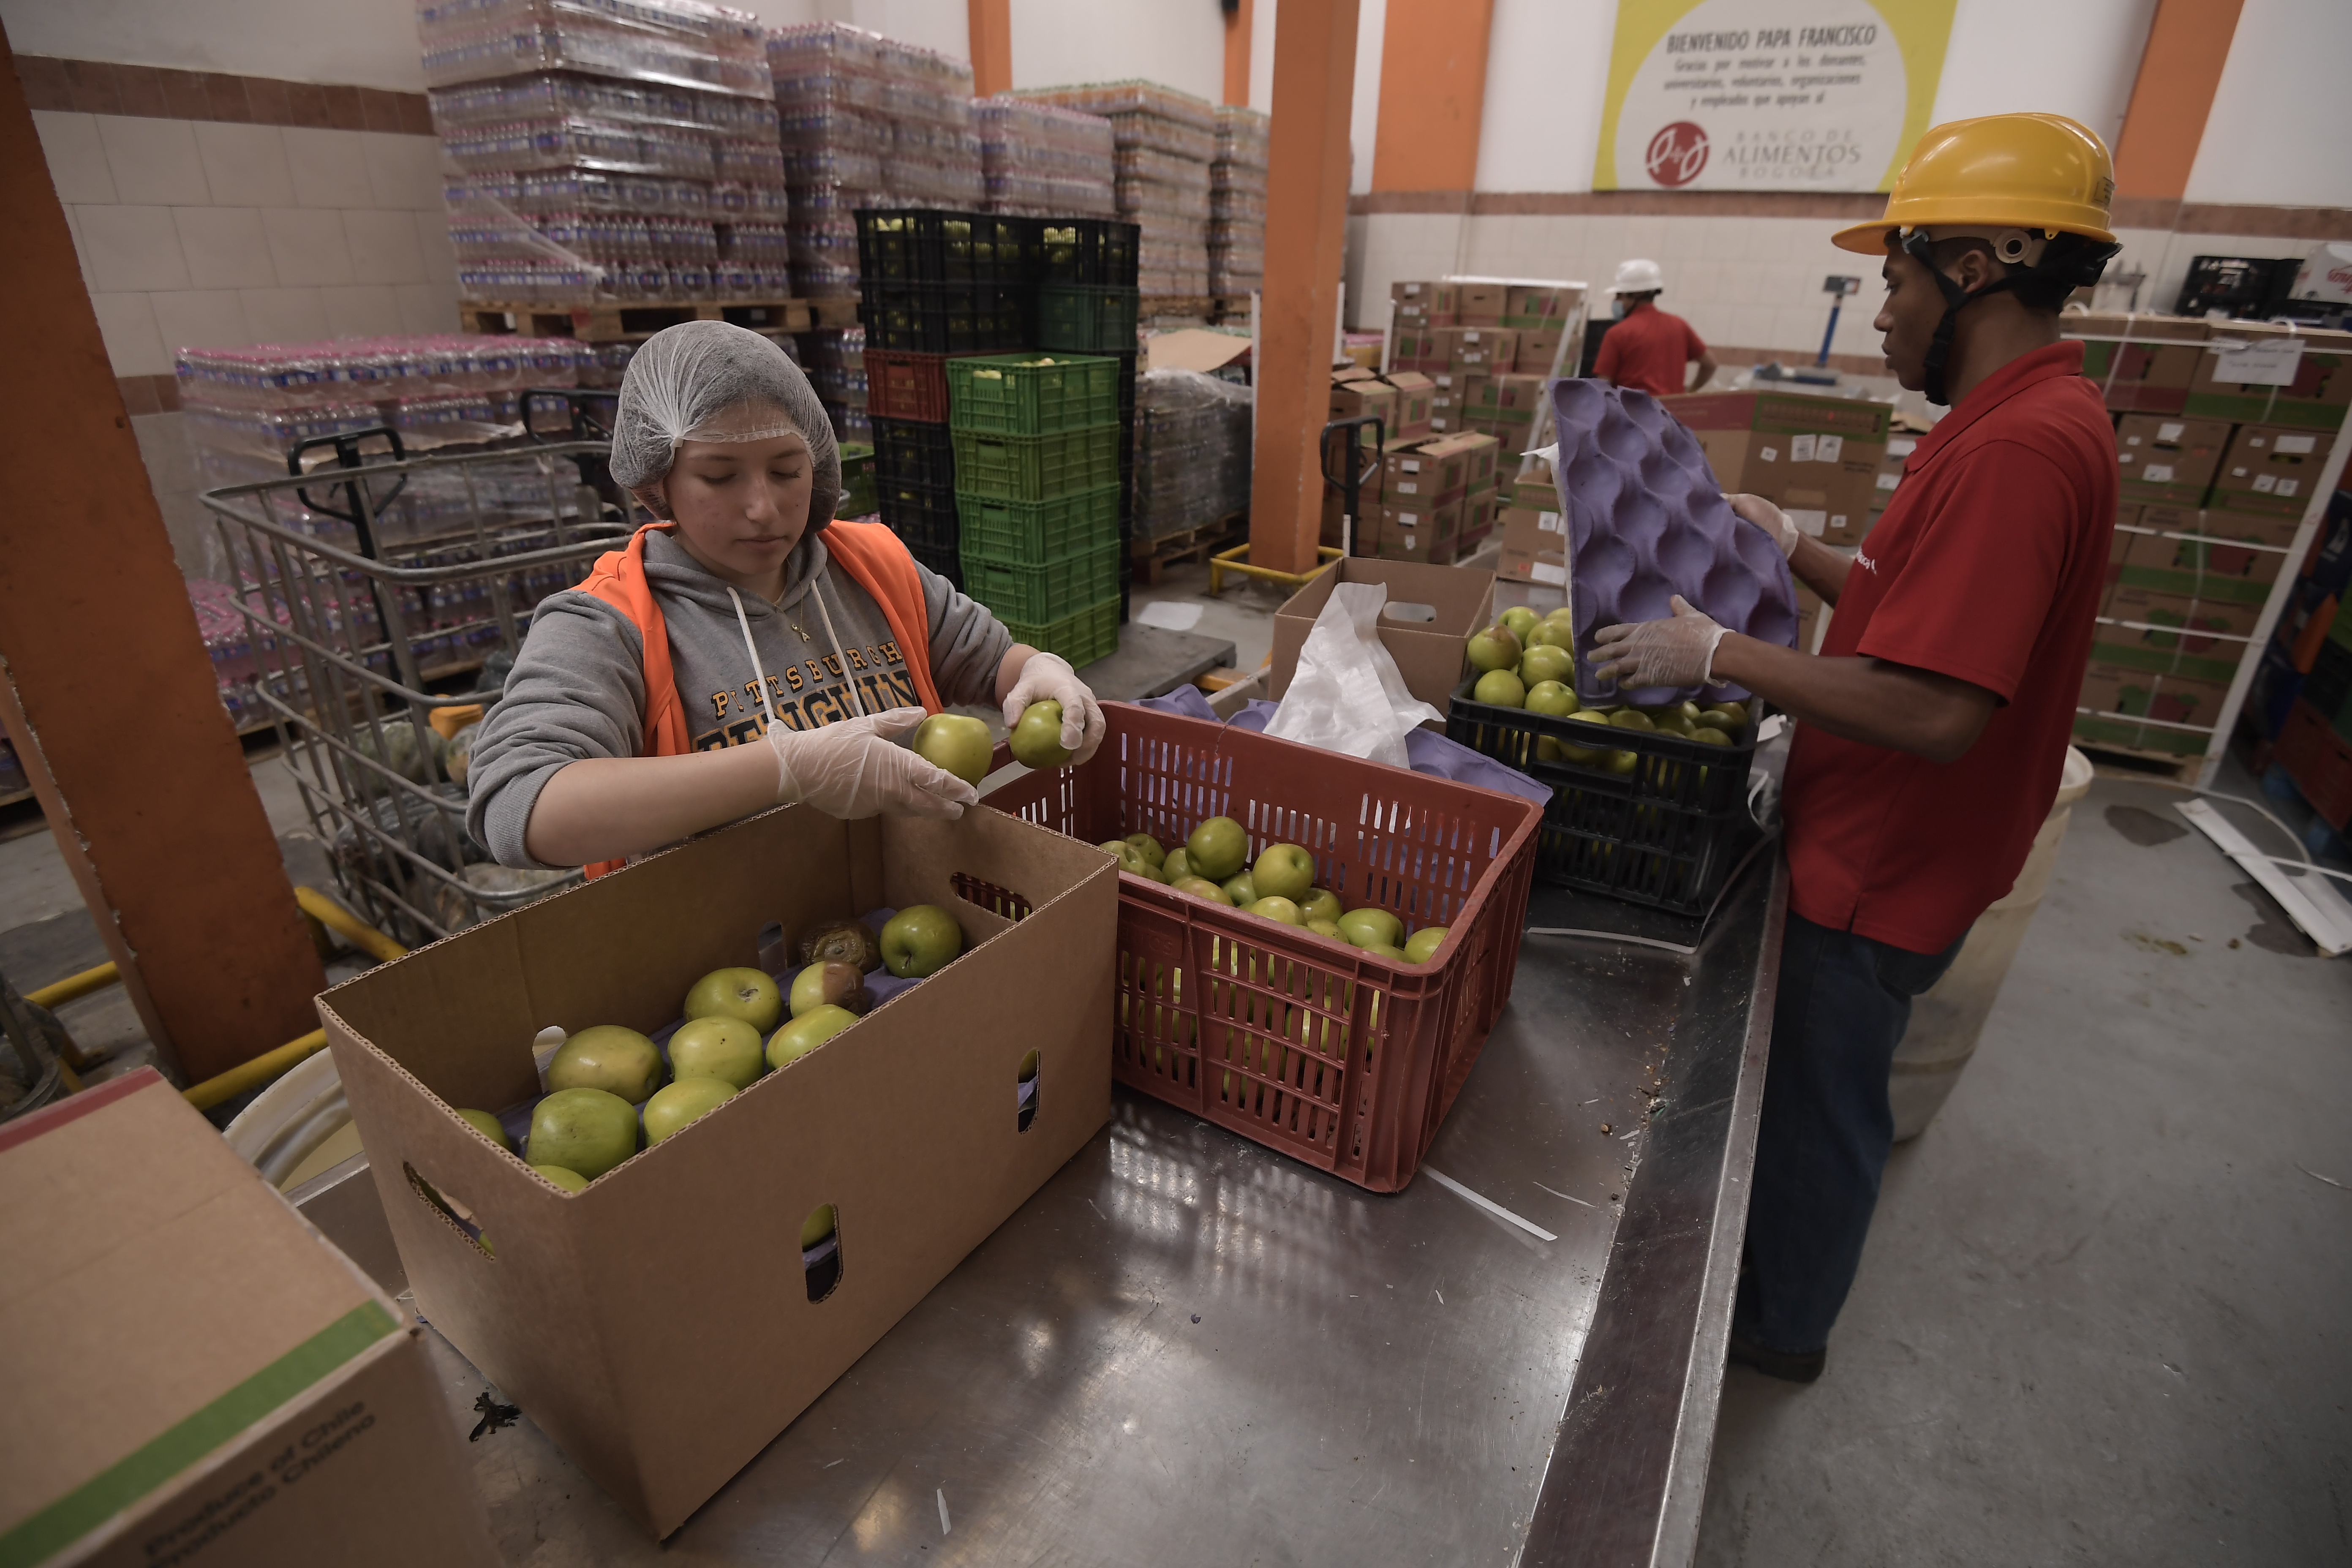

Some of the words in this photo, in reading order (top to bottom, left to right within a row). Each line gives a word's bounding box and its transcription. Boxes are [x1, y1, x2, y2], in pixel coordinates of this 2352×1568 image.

[1666, 31, 1750, 54] BIENVENIDO
[1756, 29, 1791, 49] PAPA
[1798, 24, 1877, 47] FRANCISCO
[1674, 58, 1707, 72] Gracias
[1714, 60, 1731, 74] por
[1739, 57, 1775, 69] motivar
[1798, 55, 1810, 67] los
[1790, 73, 1861, 89] organizaciones
[1701, 93, 1748, 109] empleados
[1754, 95, 1770, 106] que
[1776, 93, 1810, 108] apoyan
[1736, 129, 1816, 144] BANCO
[1826, 129, 1852, 143] DE
[1722, 144, 1862, 165] ALIMENTOS
[711, 641, 903, 720] PITTSBURGH
[282, 1414, 376, 1484] Chileno
[144, 1471, 264, 1556] Produce
[270, 1445, 294, 1472] of
[301, 1401, 365, 1448] Chile
